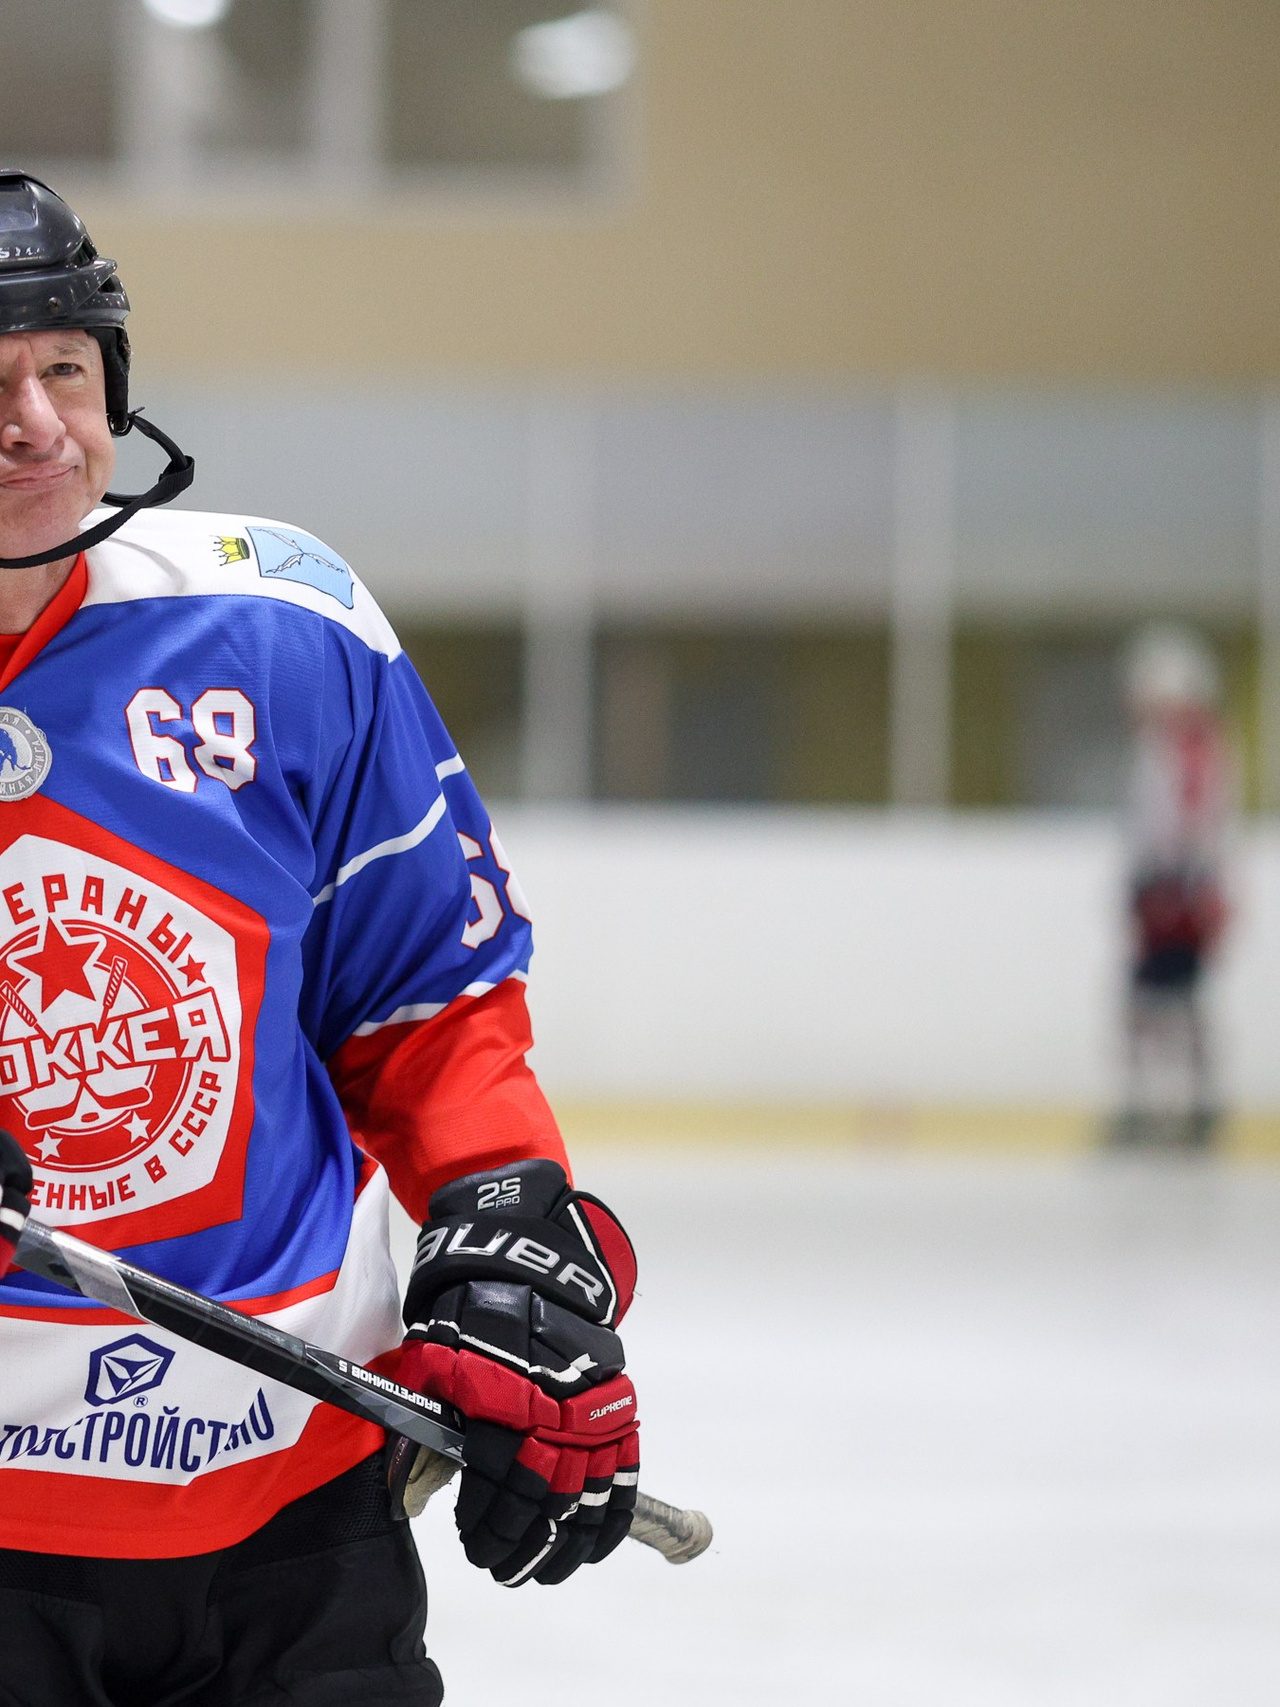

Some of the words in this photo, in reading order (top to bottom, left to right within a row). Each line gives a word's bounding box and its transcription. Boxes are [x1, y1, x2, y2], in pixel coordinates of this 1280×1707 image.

[31, 739, 46, 774] ЛИГА
[124, 686, 258, 793] 68
[143, 1154, 167, 1184] В
[169, 1070, 221, 1157] СССР
[477, 1176, 521, 1211] 2S
[495, 1195, 520, 1209] PRO
[413, 1222, 605, 1308] AUER
[351, 1365, 442, 1415] БАДРЕТДИНОВ
